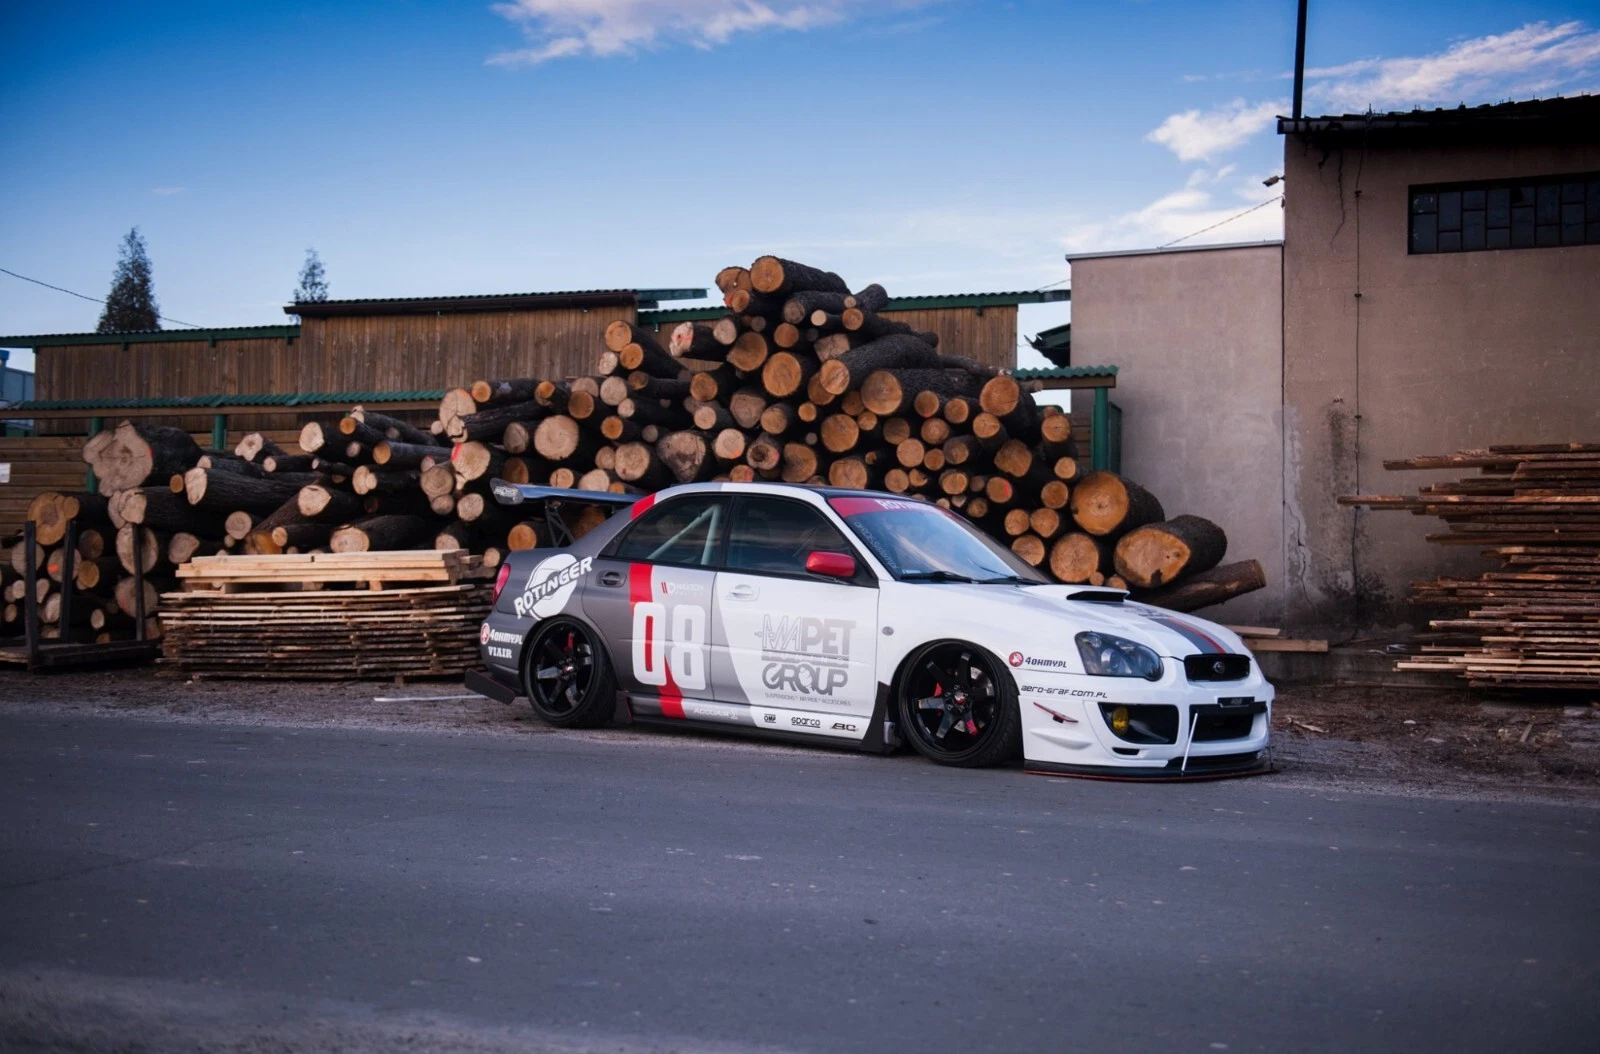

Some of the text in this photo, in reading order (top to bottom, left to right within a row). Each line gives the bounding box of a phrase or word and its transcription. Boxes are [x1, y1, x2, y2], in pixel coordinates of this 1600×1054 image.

[513, 556, 593, 619] ROTINGER
[488, 646, 512, 659] VIAIR
[632, 601, 706, 690] 08
[762, 614, 856, 655] MAPET
[762, 662, 848, 696] GROUP
[791, 716, 821, 728] sparco
